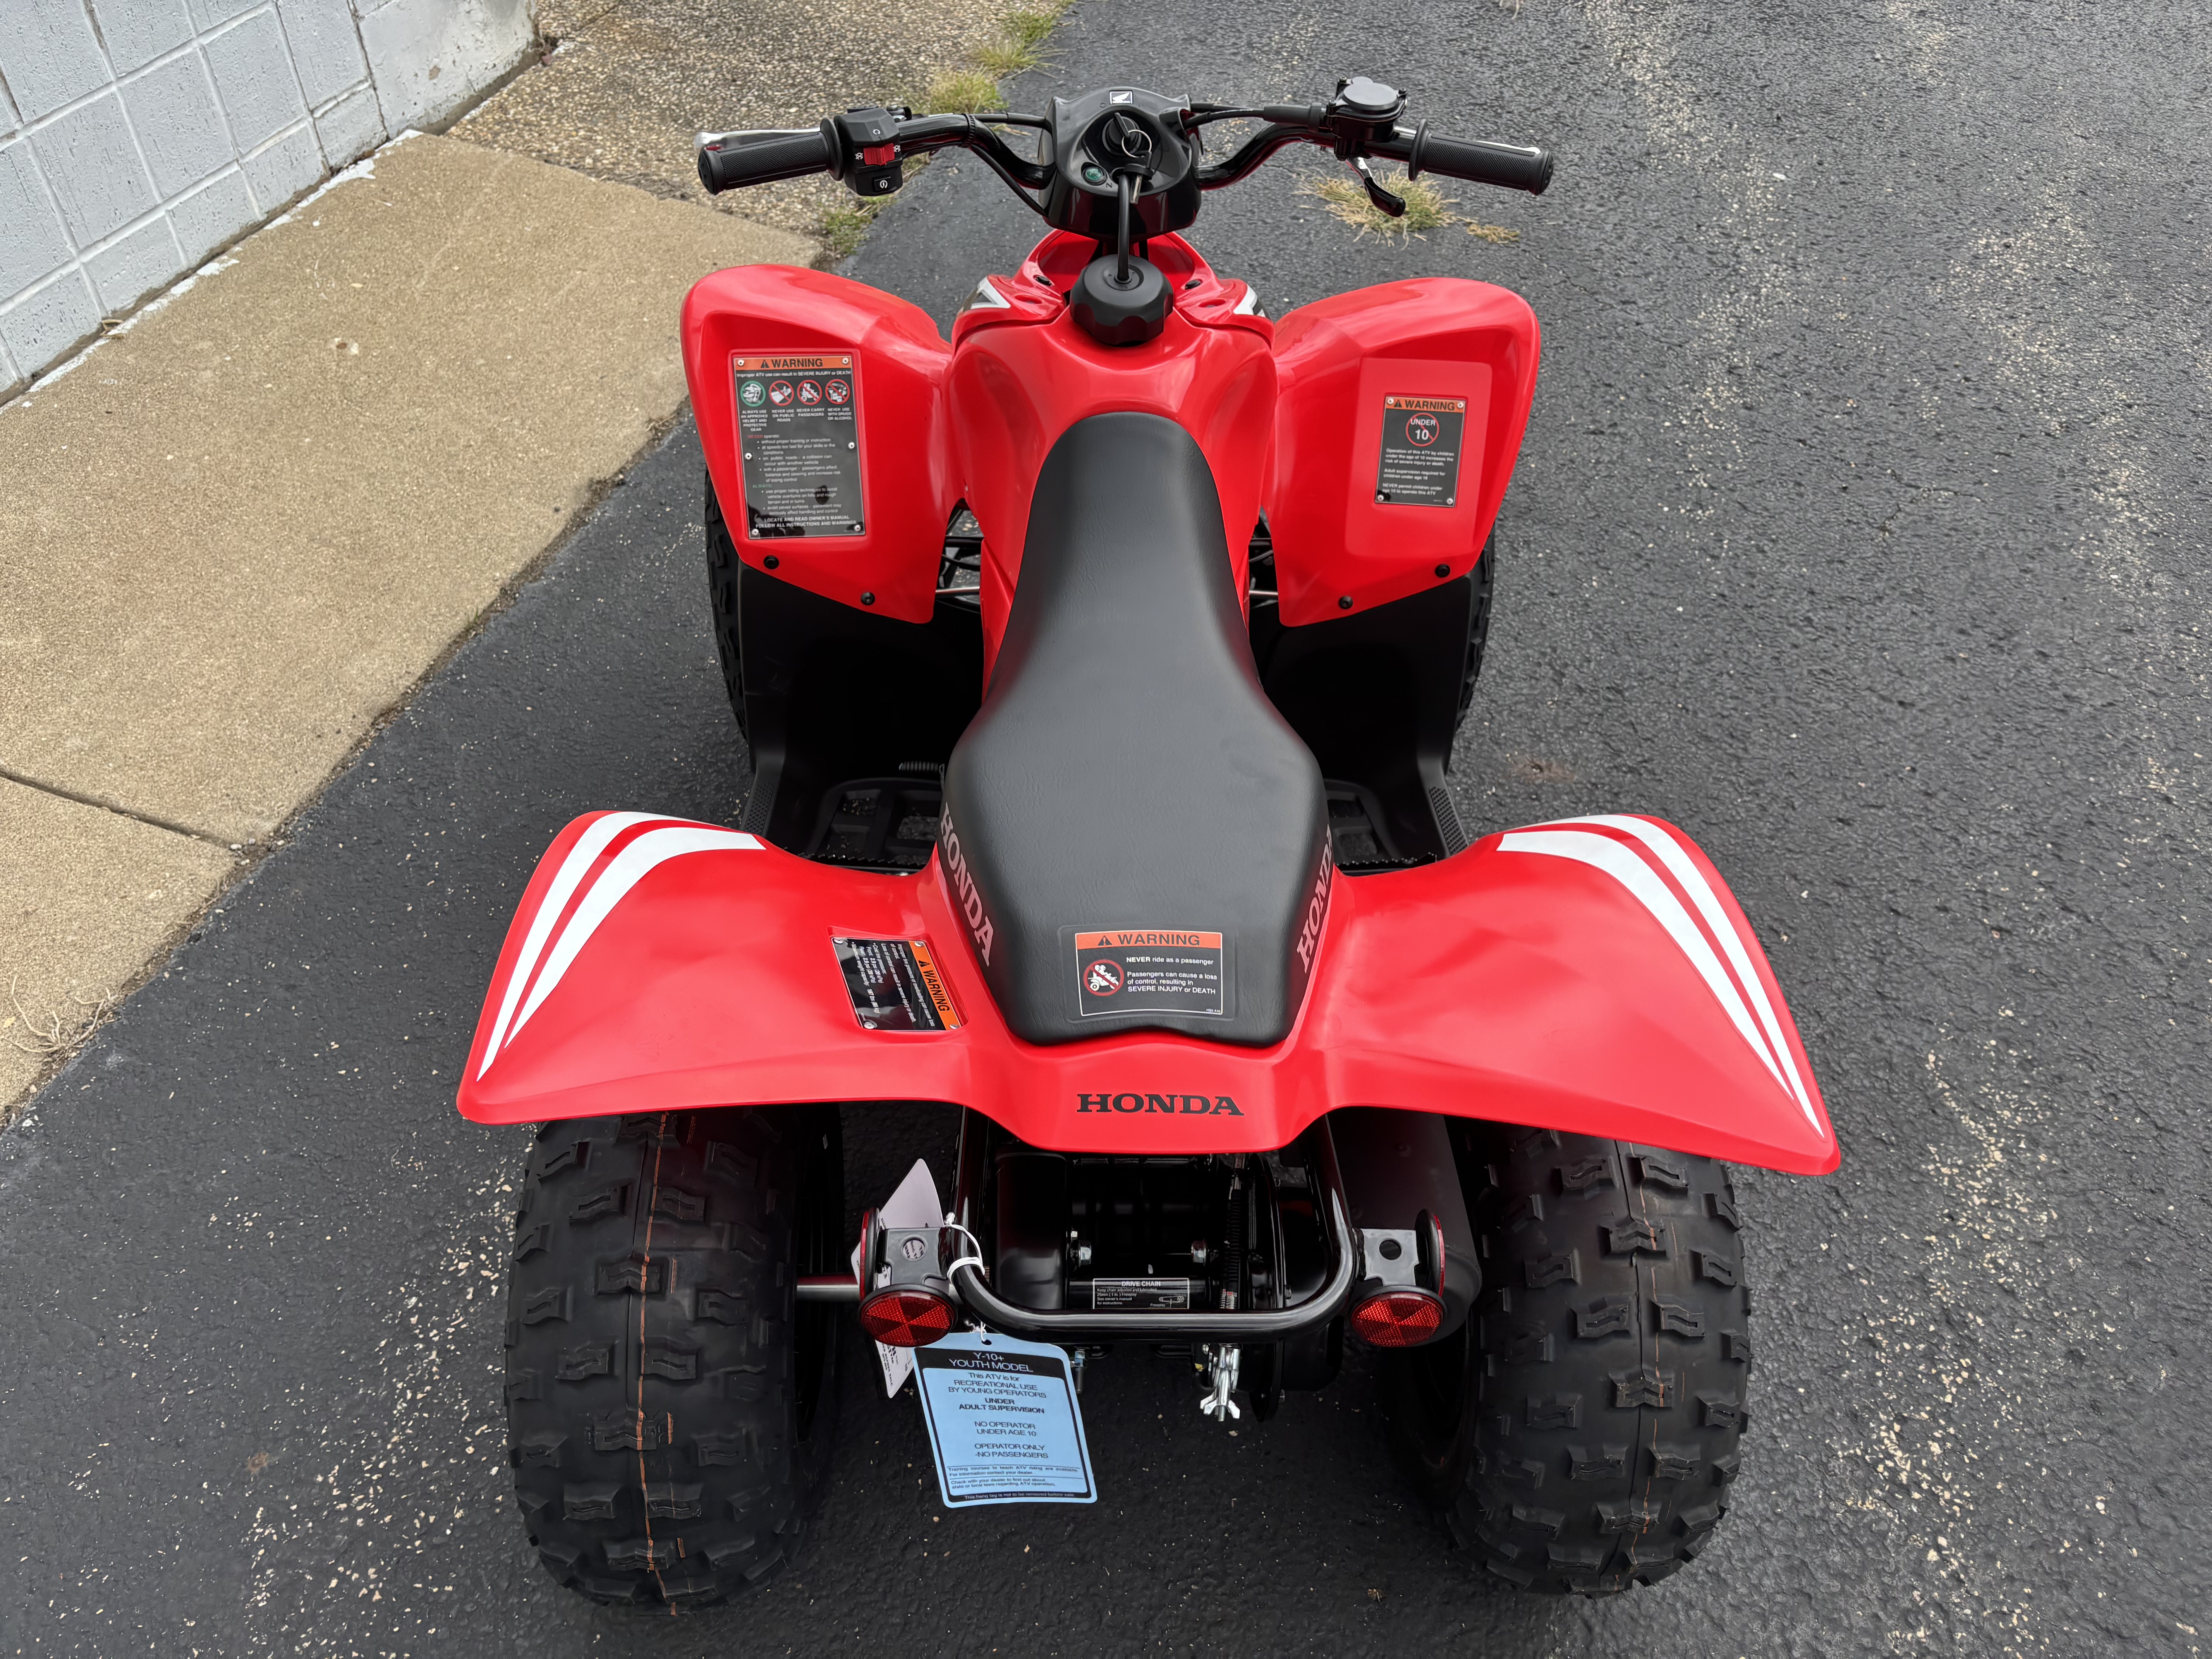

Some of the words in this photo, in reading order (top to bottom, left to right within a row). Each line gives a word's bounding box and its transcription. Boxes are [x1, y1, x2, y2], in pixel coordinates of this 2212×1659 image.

[772, 359, 823, 368] WARNING
[1405, 400, 1455, 410] WARNING
[1415, 429, 1429, 440] 10
[941, 801, 993, 967] HONDA
[1297, 824, 1332, 974] HONDA
[1118, 934, 1200, 946] WARNING
[923, 970, 950, 1012] WARNING
[1077, 1094, 1245, 1116] HONDA
[974, 1352, 1004, 1361] Y-10+
[949, 1359, 990, 1368] YOUTH
[992, 1362, 1034, 1372] MODEL
[954, 1380, 1019, 1389] RECREATIONAL
[994, 1389, 1046, 1398] OPERATORS
[989, 1405, 1044, 1413] SUPERVISION
